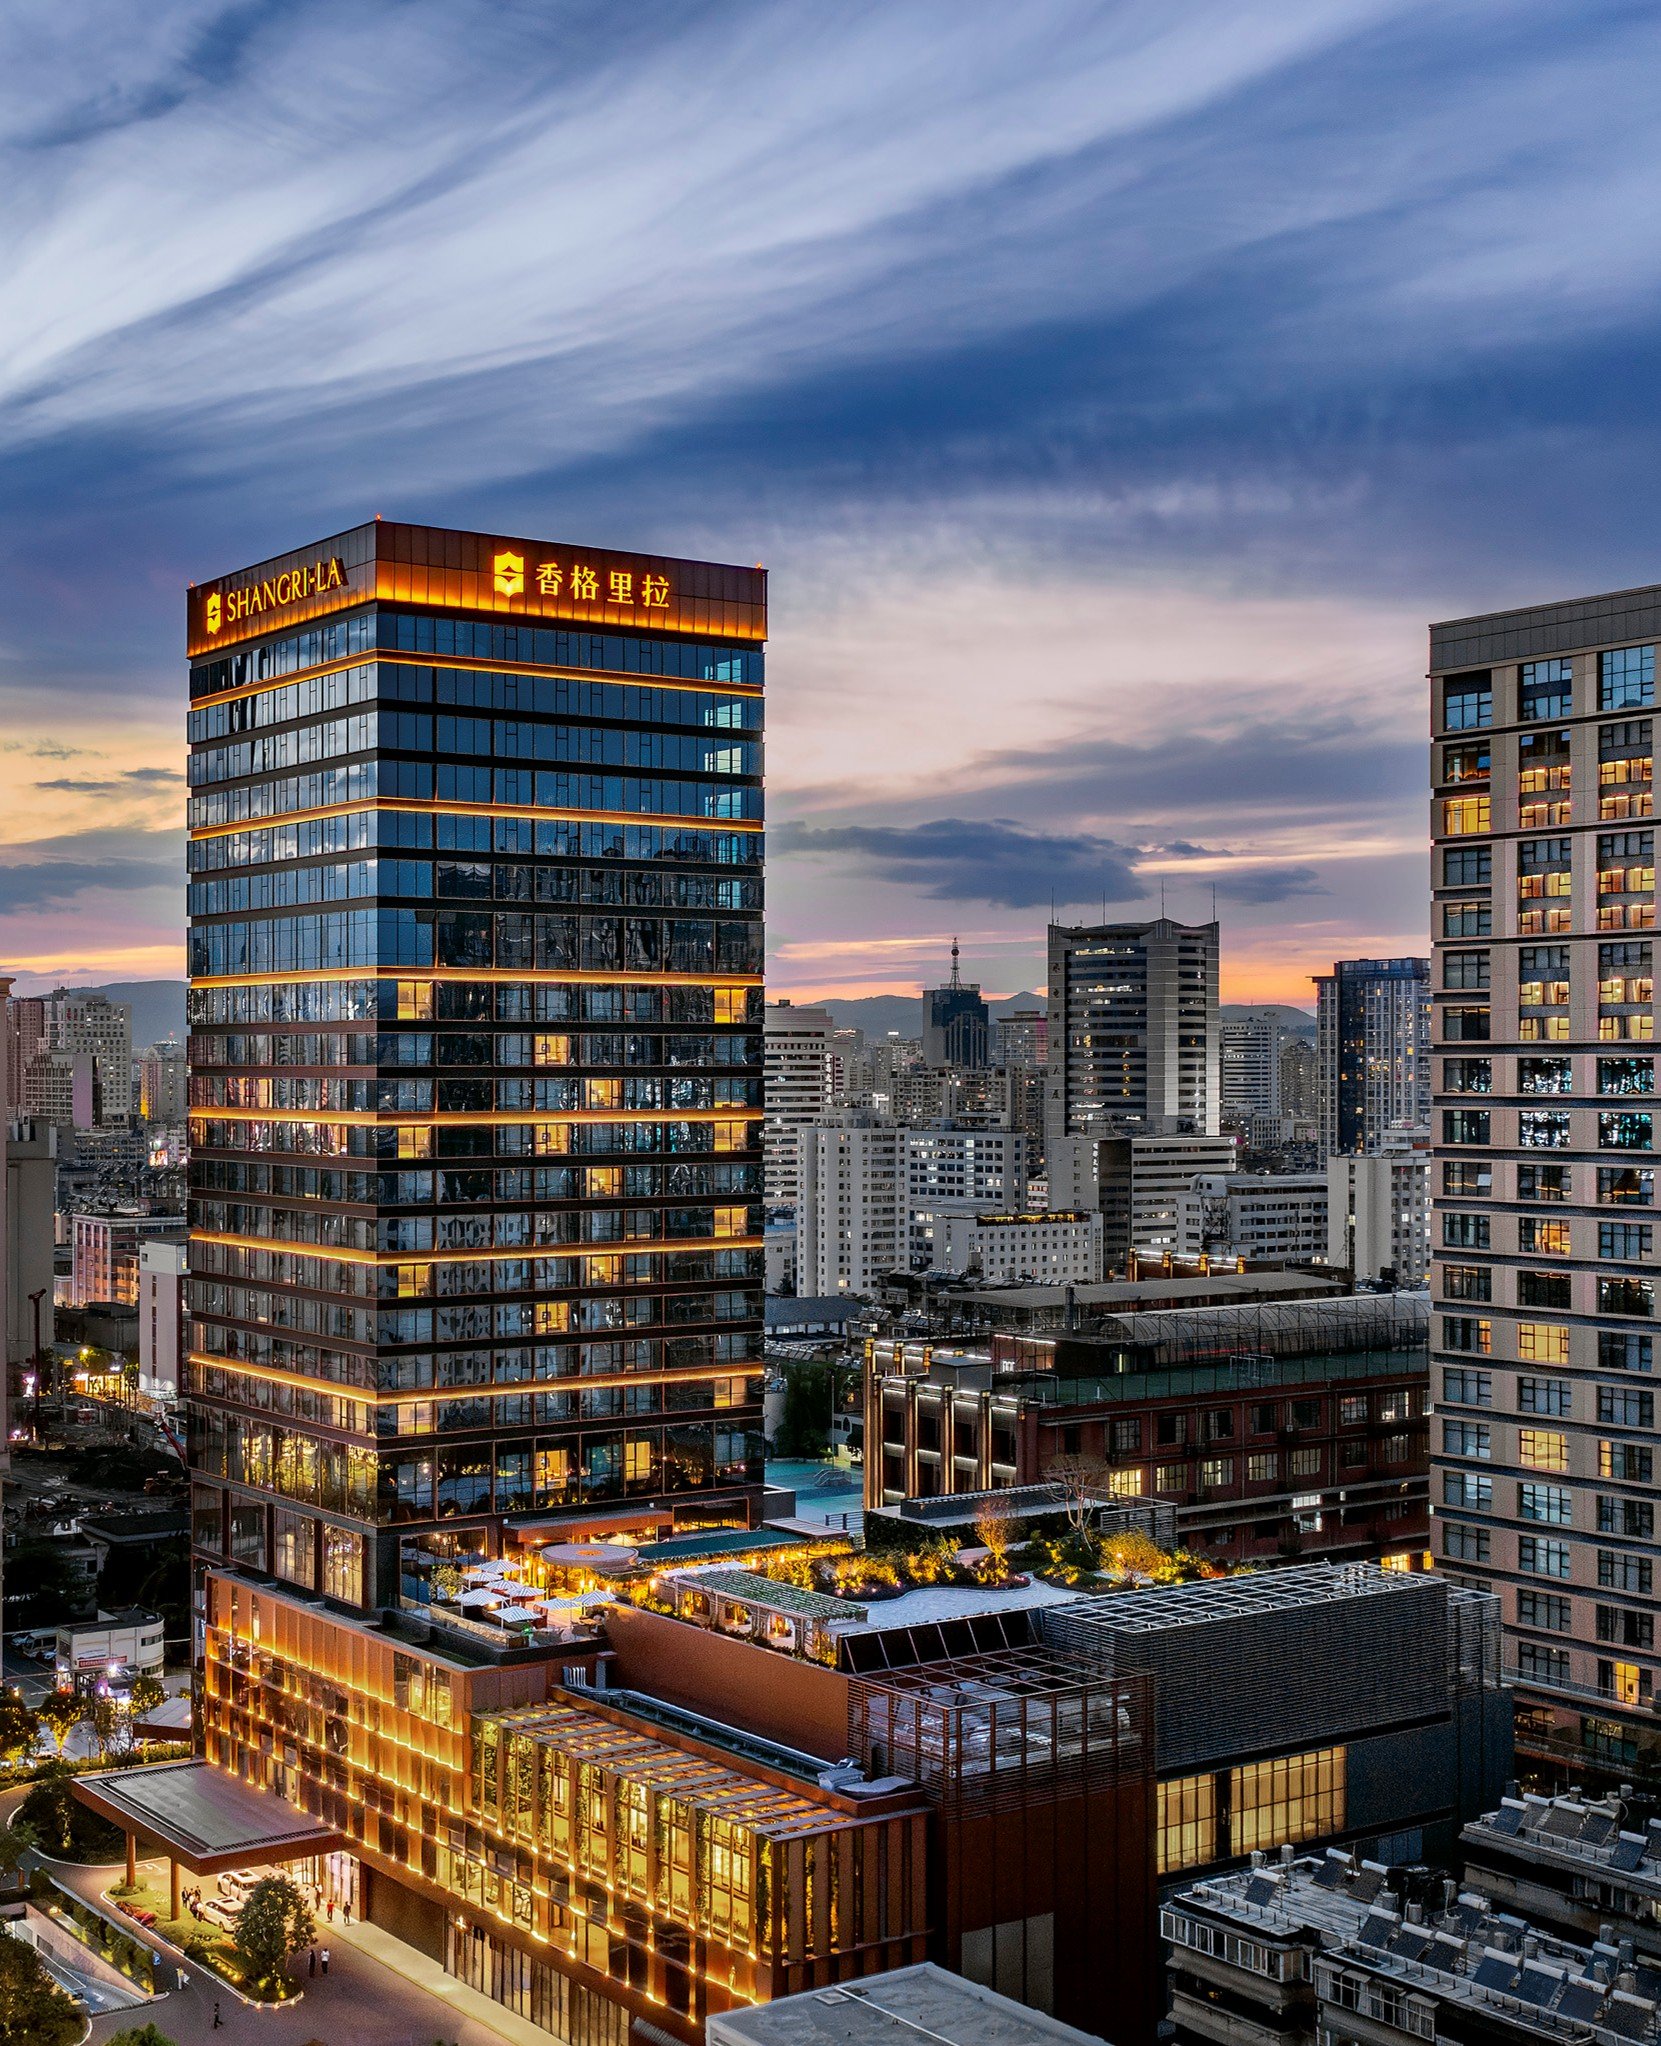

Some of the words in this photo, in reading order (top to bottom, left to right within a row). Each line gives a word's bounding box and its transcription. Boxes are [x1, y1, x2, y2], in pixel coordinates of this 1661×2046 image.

[226, 556, 342, 622] SHANGRI-LA
[535, 562, 670, 608] 香格里拉
